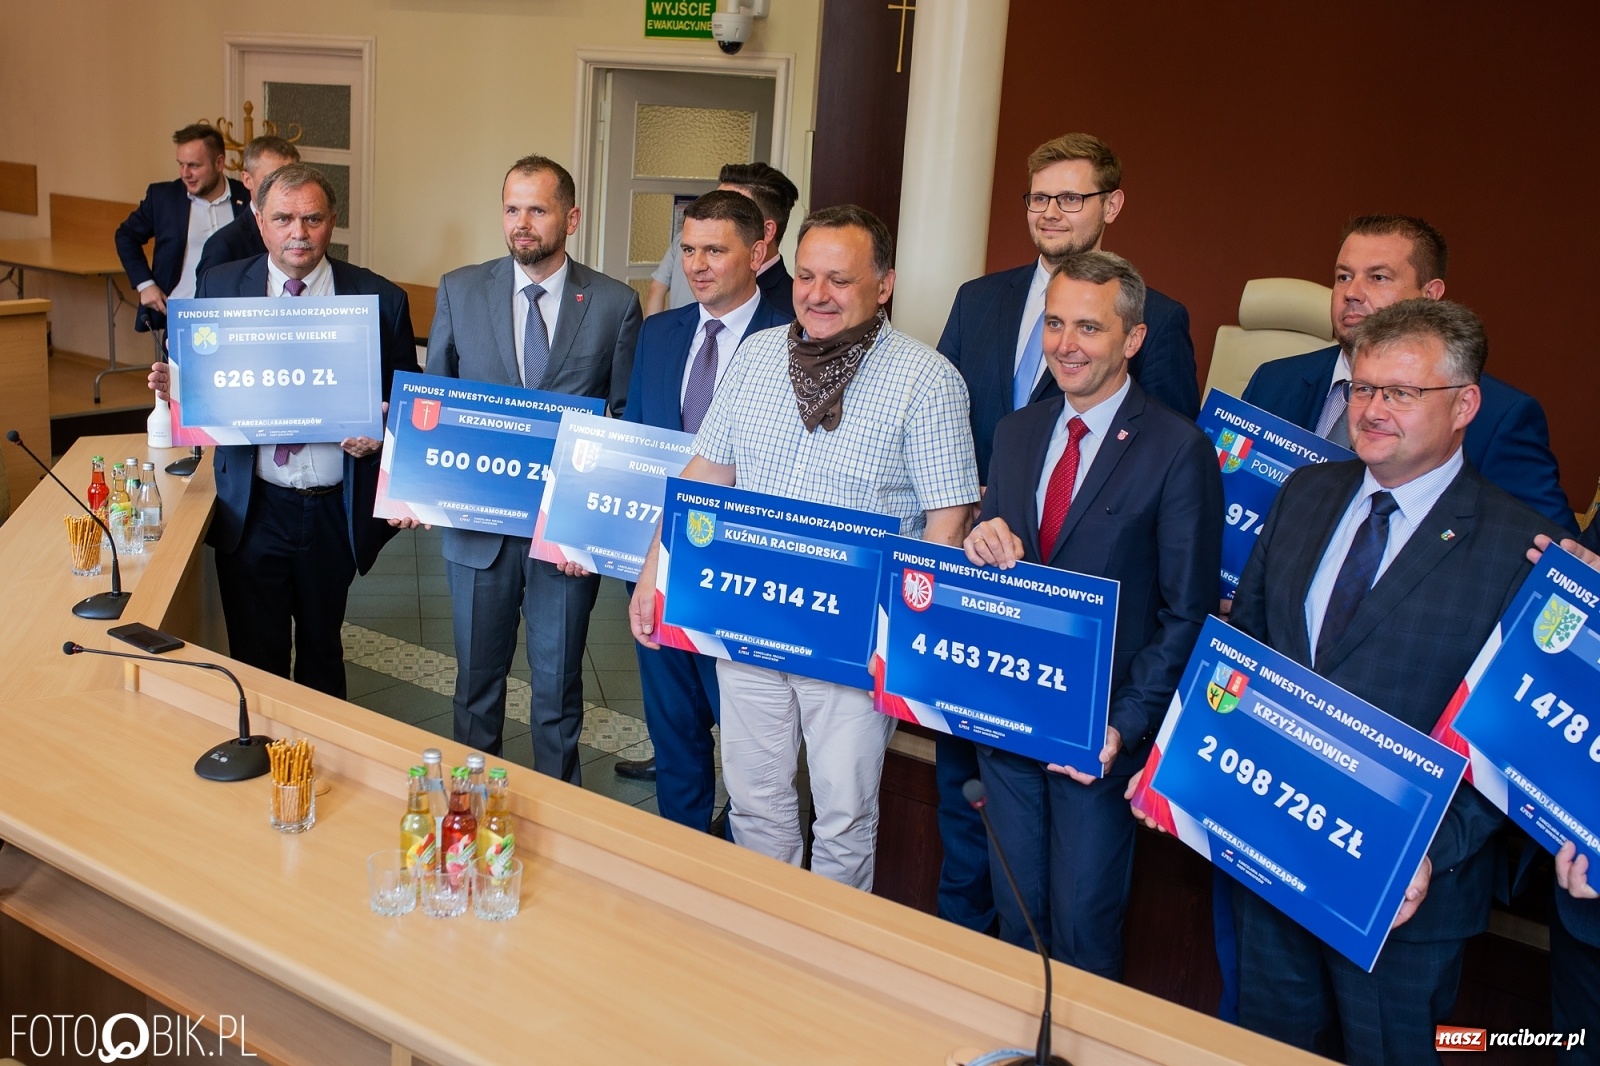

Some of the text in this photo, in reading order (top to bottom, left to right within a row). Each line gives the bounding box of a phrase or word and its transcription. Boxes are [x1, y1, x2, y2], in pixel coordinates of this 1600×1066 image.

[652, 0, 711, 16] WYJŚCIE
[647, 20, 712, 31] EWAKUACYJNE
[178, 306, 368, 319] FUNDUSZ INWESTYCJI SAMORZĄDOWYCH
[228, 331, 337, 342] PIETROWICE WIELKIE
[214, 368, 338, 388] 626 860 ZŁ
[403, 383, 445, 397] FUNDUSZ
[448, 389, 503, 405] INWESTYCJI
[459, 414, 531, 433] KRZANOWICE
[1214, 407, 1262, 436] FUNDUSZ
[568, 424, 696, 456] FUNDUSZ INWESTYCJI SAMORZ
[425, 448, 470, 470] 500
[476, 455, 521, 477] 000
[629, 460, 666, 476] RUDNIK
[587, 492, 662, 524] 531 377
[676, 492, 885, 538] FUNDUSZ INWESTYCJI SAMORZĄDOWYCH
[586, 546, 646, 564] #TARCZADLASAMOR
[724, 528, 848, 562] KUŹNIA RACIBORSKA
[700, 568, 840, 615] 2 717 314 ZŁ
[893, 551, 1104, 605] FUNDUSZ INWESTYCJI SAMORZĄDOWYCH
[1546, 567, 1600, 608] FUNDUSZ
[961, 596, 1021, 620] RACIBÓRZ
[715, 630, 813, 656] #TARCZADLASAMORZĄDÓW
[912, 633, 1067, 692] 4 453 723 ZŁ
[935, 700, 1033, 734] #TARCZADLASAMORZĄDÓW
[1209, 638, 1444, 779] FUNDUSZ INWESTYCJI SAMORZĄDOWYCH
[1513, 672, 1600, 763] 1 478 6
[1253, 702, 1360, 774] KRZYŻANOWICE
[1197, 735, 1364, 860] 2 098 726 ZŁ
[1202, 818, 1306, 892] #TARCZADLASAMORZĄDÓW
